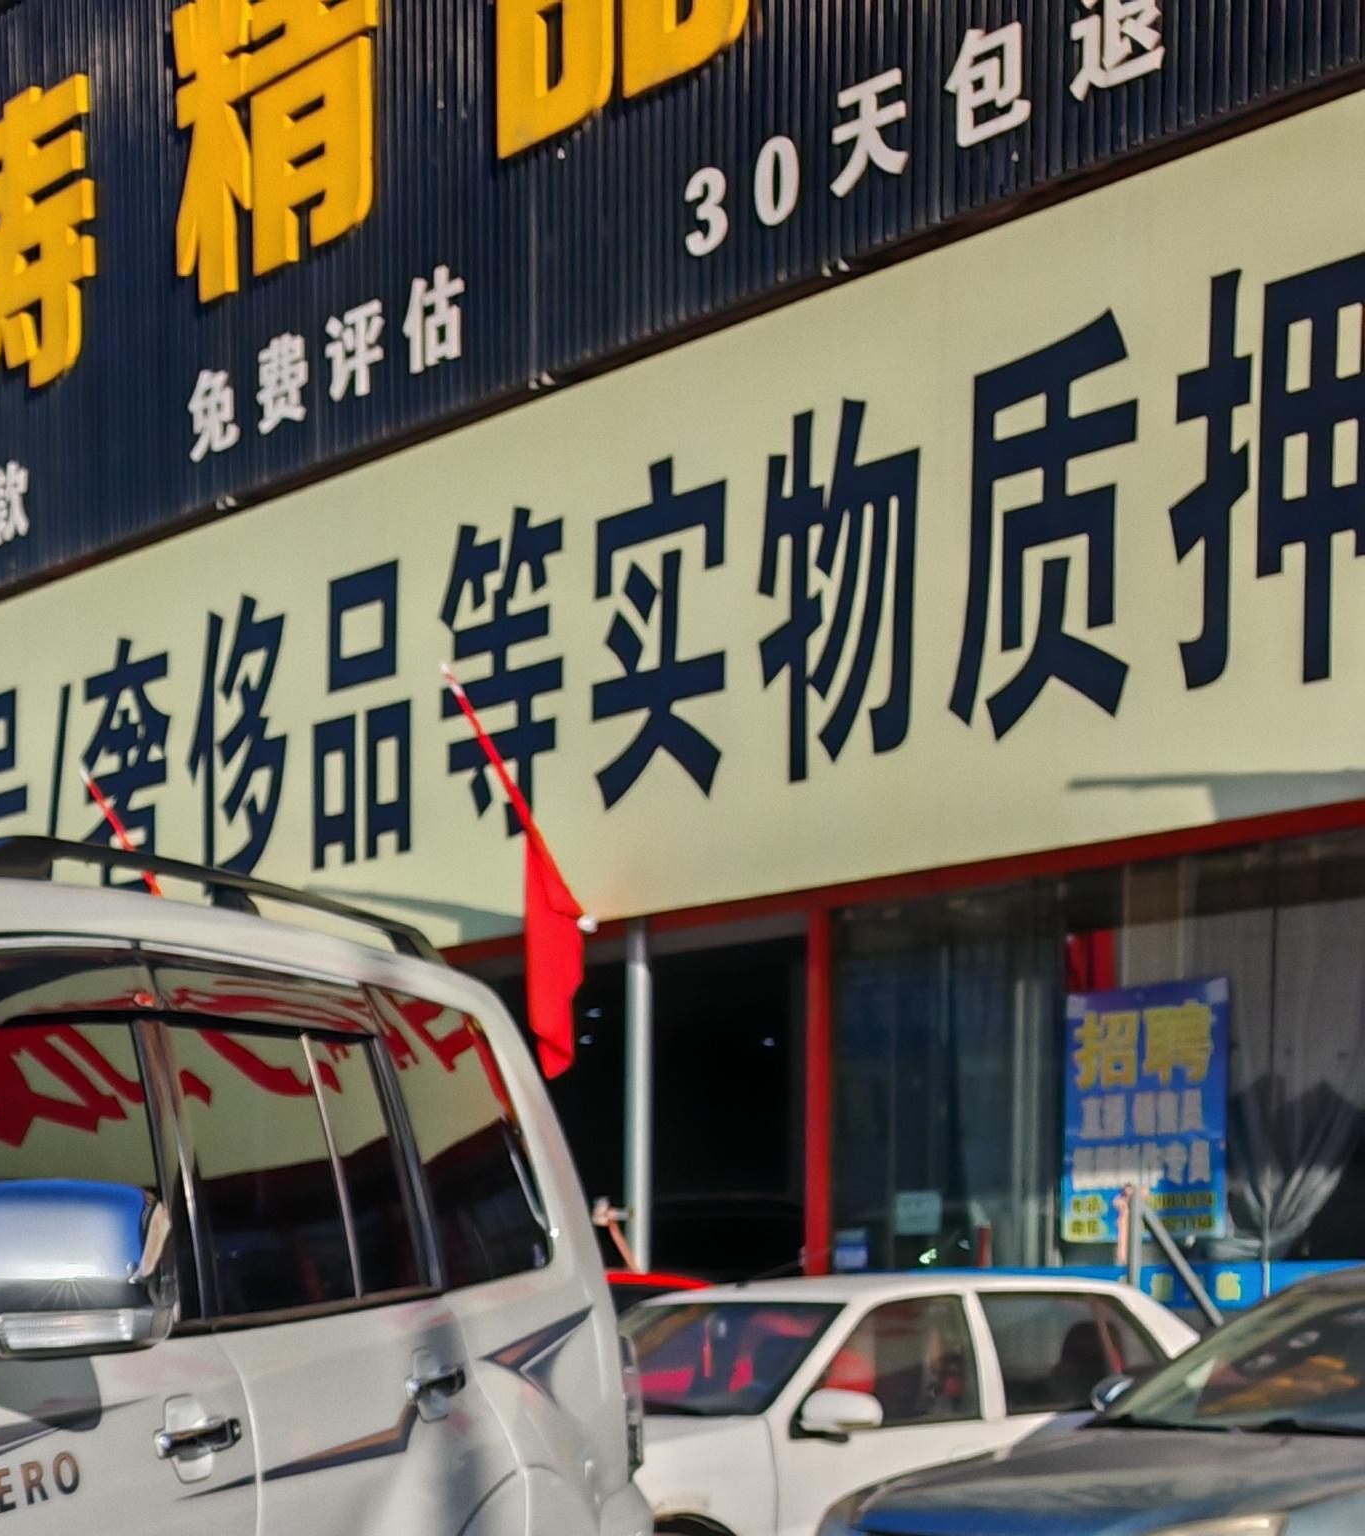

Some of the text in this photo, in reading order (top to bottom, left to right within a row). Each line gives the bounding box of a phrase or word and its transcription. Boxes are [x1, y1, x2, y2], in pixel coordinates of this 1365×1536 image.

[187, 263, 466, 463] 免费评估
[1072, 998, 1215, 1091] 招聘
